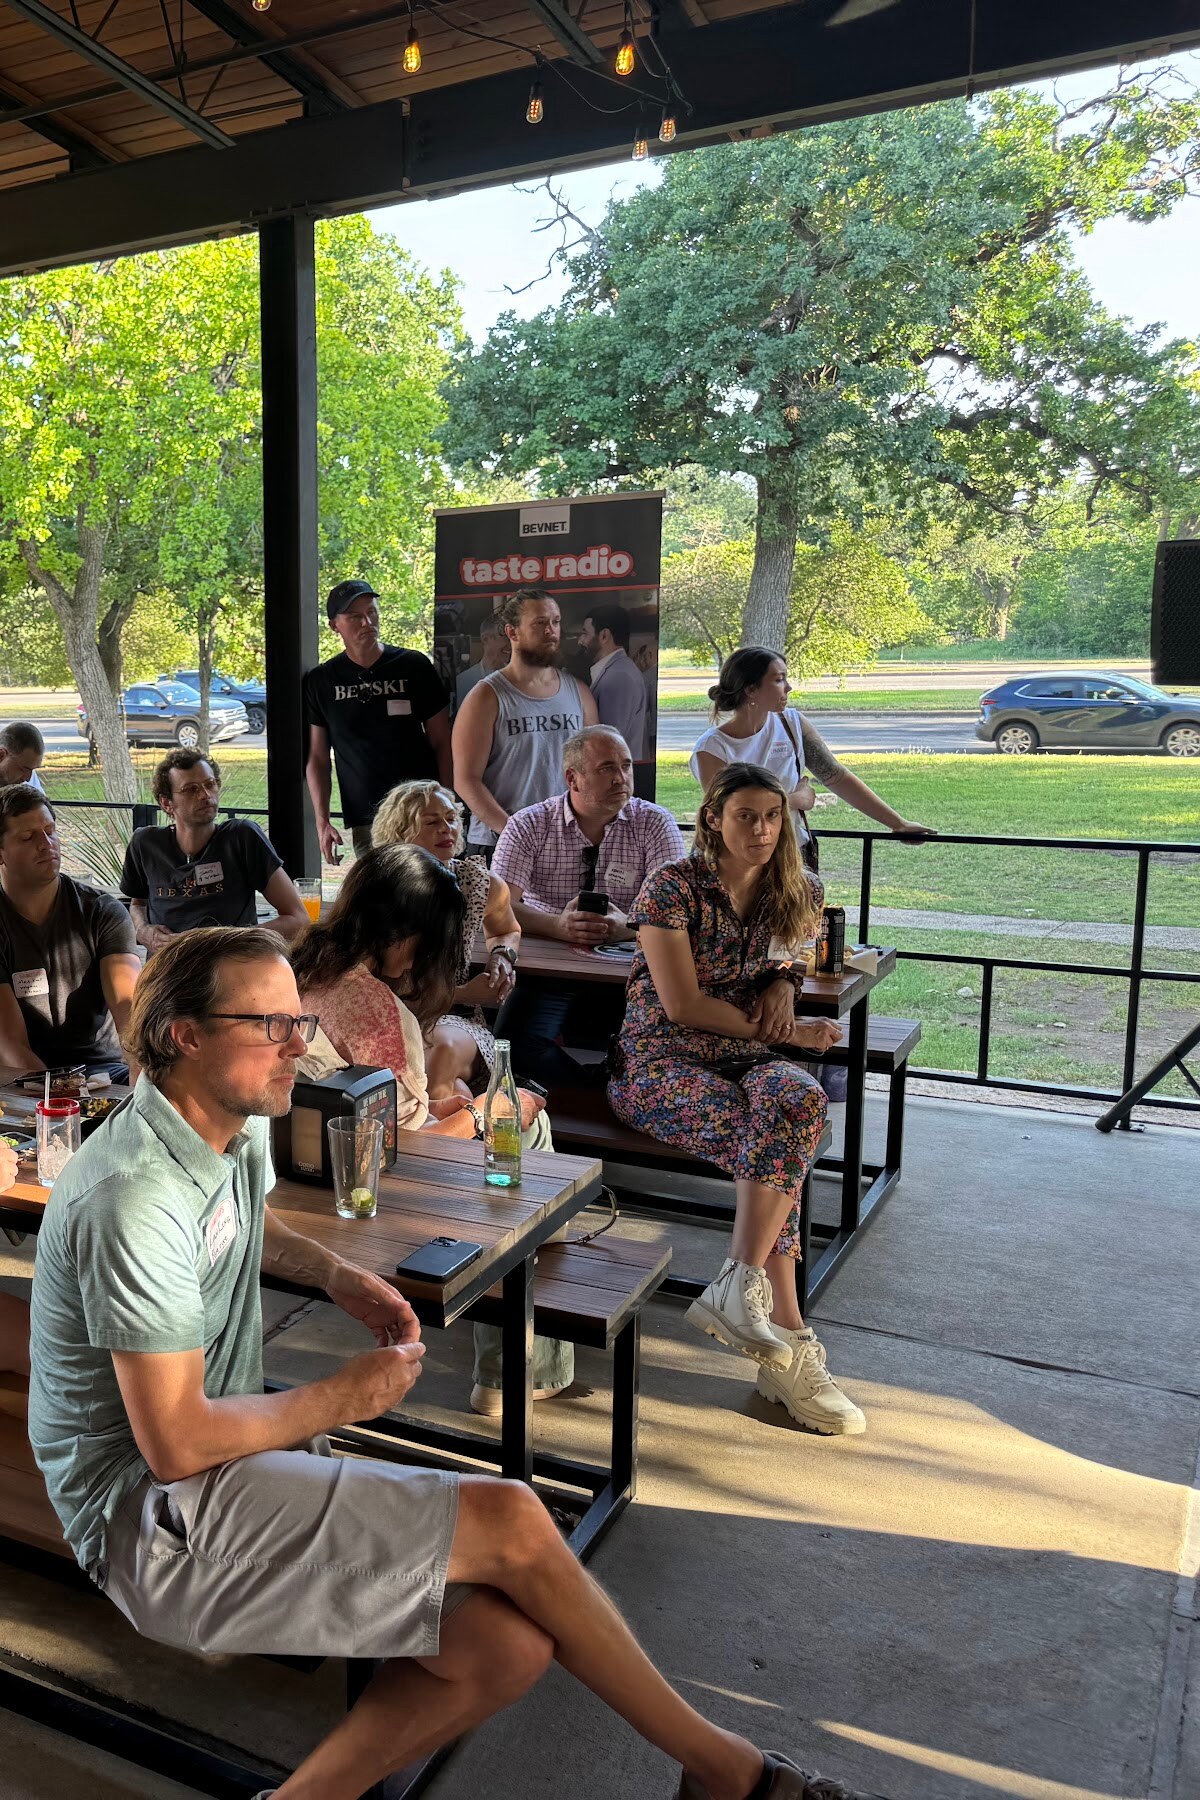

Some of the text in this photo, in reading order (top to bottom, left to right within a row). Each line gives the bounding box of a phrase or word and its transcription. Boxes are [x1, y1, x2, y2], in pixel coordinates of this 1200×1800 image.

[522, 521, 567, 534] BEVNET
[461, 547, 631, 584] taste radio
